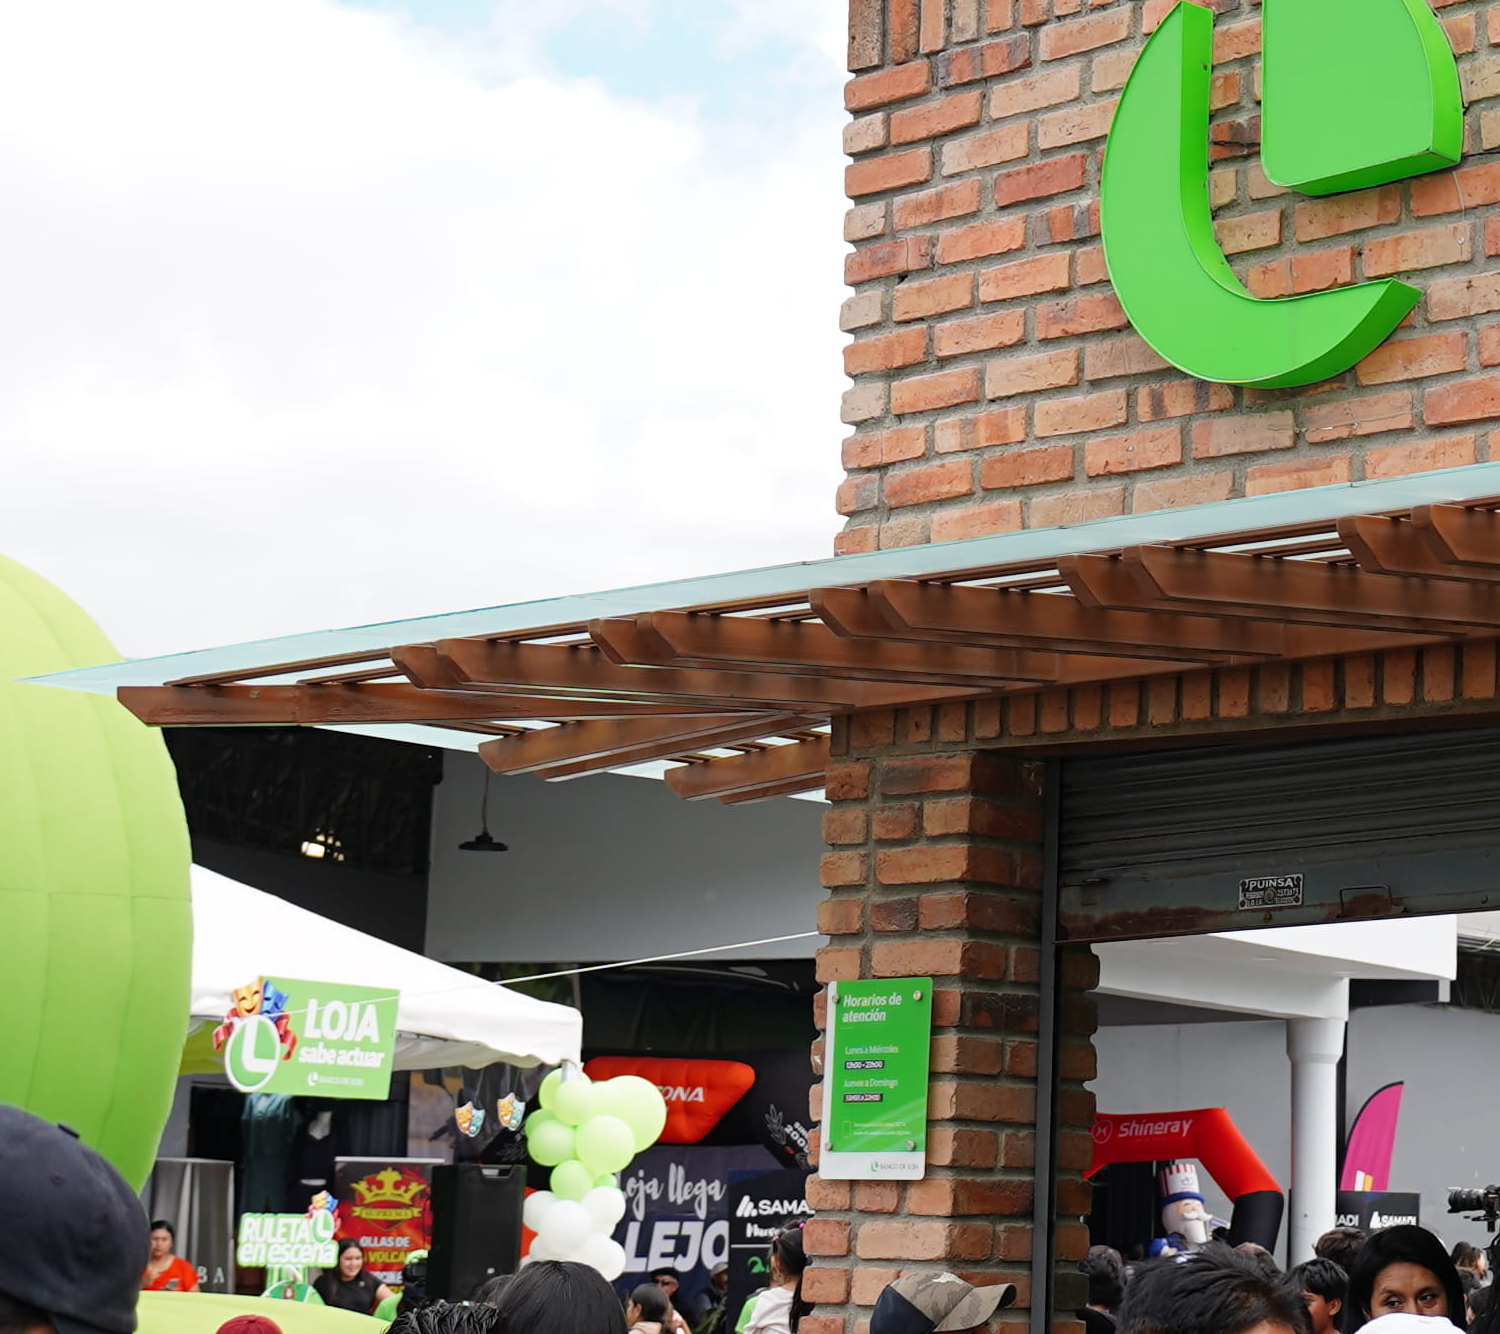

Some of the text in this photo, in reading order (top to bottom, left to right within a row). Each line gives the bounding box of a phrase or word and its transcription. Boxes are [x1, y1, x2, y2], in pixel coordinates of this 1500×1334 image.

[1249, 878, 1294, 891] PUINSA
[843, 992, 903, 1007] Horarios de
[303, 998, 380, 1043] LOJA
[842, 1008, 886, 1022] atención
[298, 1041, 386, 1068] sabe actuar
[623, 1163, 728, 1221] oja llega
[758, 1199, 816, 1215] SAMA
[1336, 1214, 1360, 1227] ADI
[1381, 1215, 1417, 1227] SAMADI
[241, 1216, 311, 1243] RULETA
[240, 1241, 335, 1264] en escena
